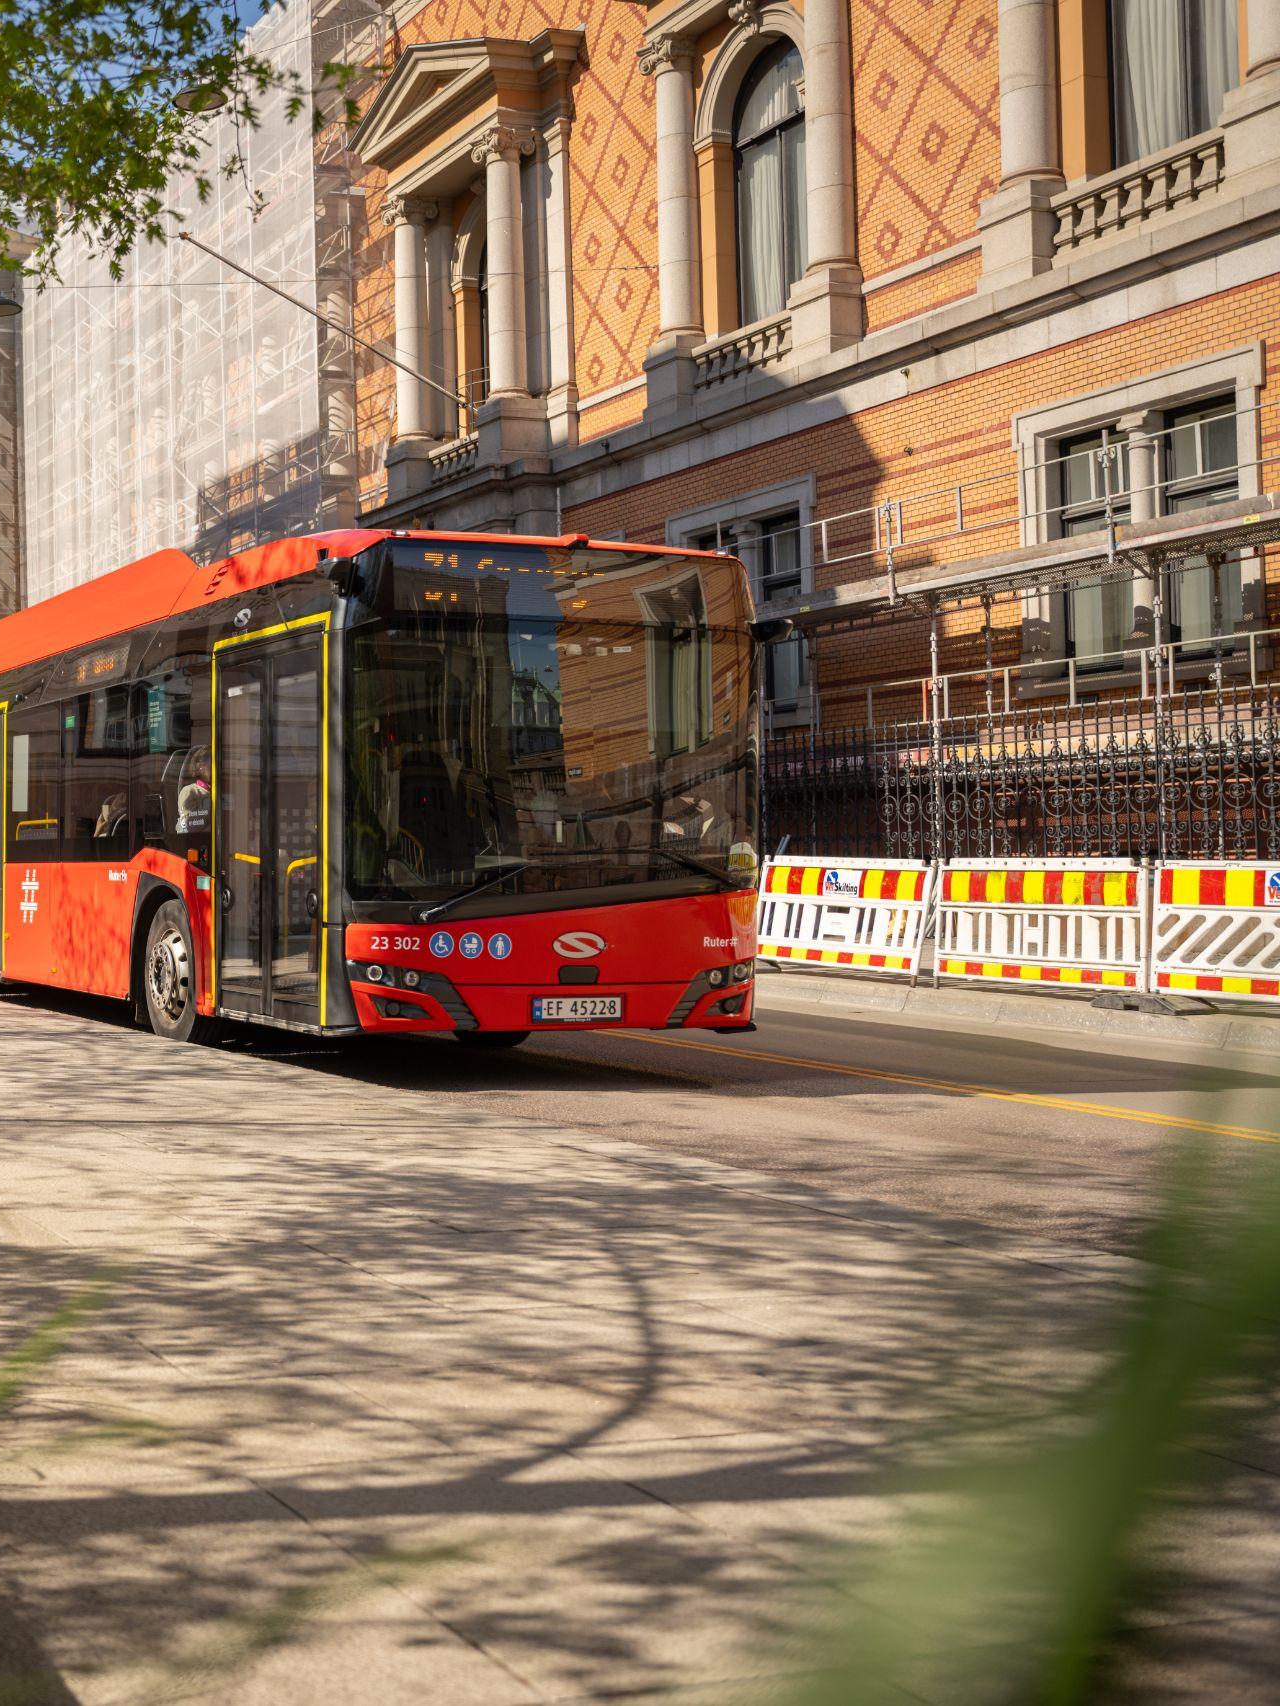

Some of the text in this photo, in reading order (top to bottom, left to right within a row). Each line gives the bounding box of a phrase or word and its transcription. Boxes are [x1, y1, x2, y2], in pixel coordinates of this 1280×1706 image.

[370, 936, 420, 950] 23 302
[546, 1000, 617, 1016] EF 45228
